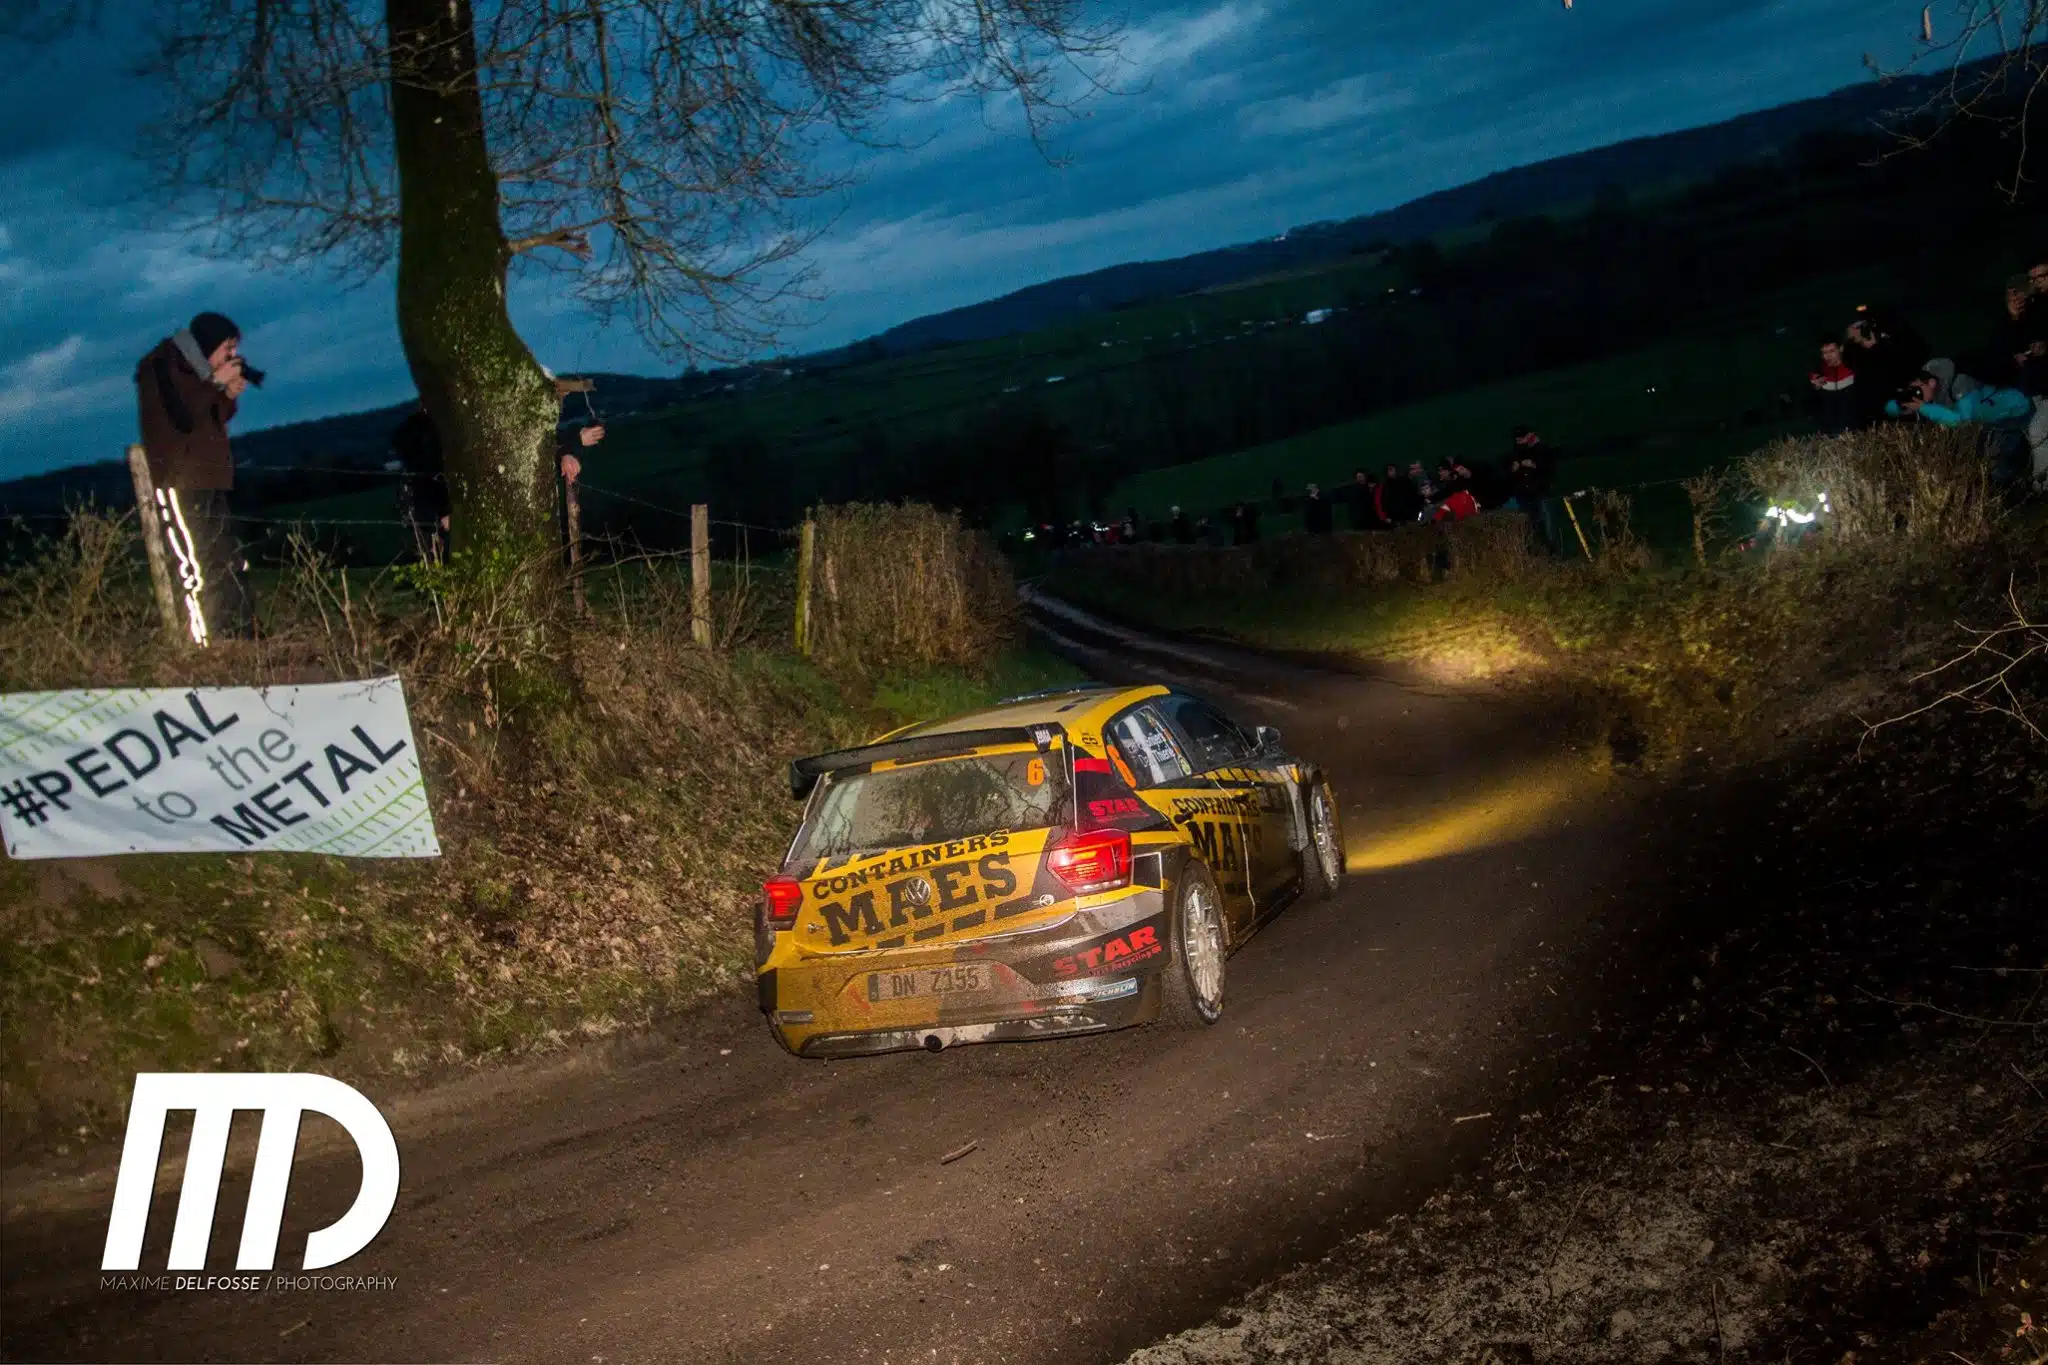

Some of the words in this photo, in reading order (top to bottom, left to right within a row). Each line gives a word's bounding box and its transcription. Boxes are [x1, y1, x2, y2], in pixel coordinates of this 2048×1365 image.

[1, 691, 240, 828] #PEDAL
[132, 791, 198, 825] to
[206, 727, 297, 791] the
[210, 724, 407, 846] METAL
[1027, 758, 1045, 786] 6
[1088, 798, 1141, 817] STAR
[812, 830, 1010, 899] CONTAINERS
[818, 850, 1017, 947] MAES
[1054, 925, 1159, 975] STAR
[891, 973, 916, 997] DN
